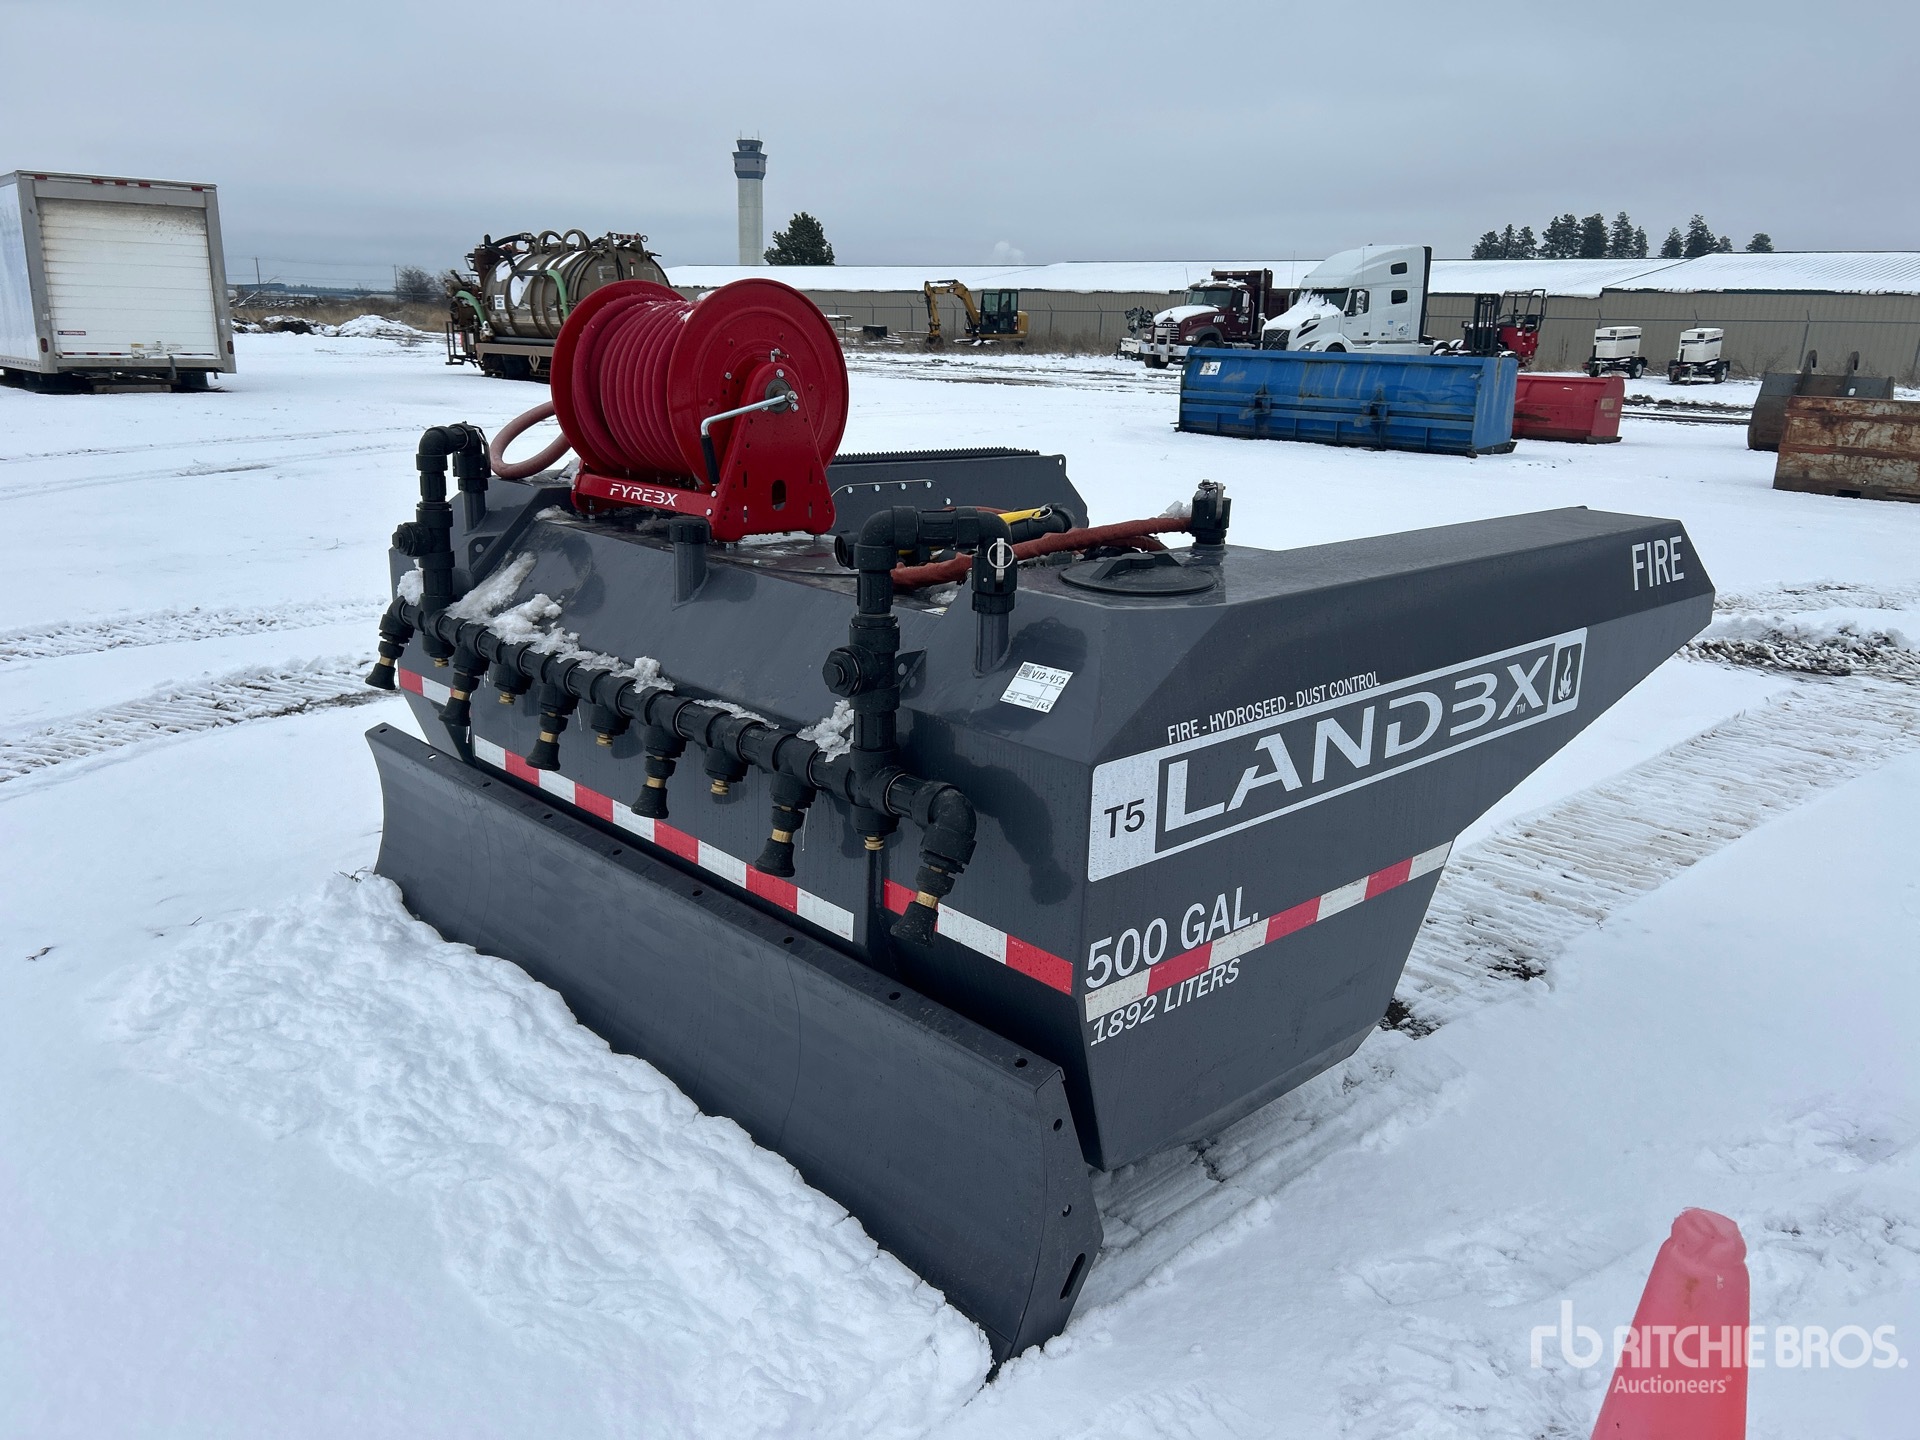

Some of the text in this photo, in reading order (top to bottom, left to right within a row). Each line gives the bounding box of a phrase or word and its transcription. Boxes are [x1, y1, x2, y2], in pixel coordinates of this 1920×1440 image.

[1631, 535, 1685, 591] FIRE
[1167, 719, 1200, 744] FIRE
[1209, 696, 1287, 732] HYDROSEED
[1296, 684, 1327, 708] DUST
[1329, 670, 1380, 698] CONTROL
[1104, 798, 1145, 838] T5
[1085, 886, 1259, 989] 500 GAL.
[1090, 957, 1241, 1047] 1892 LITERS
